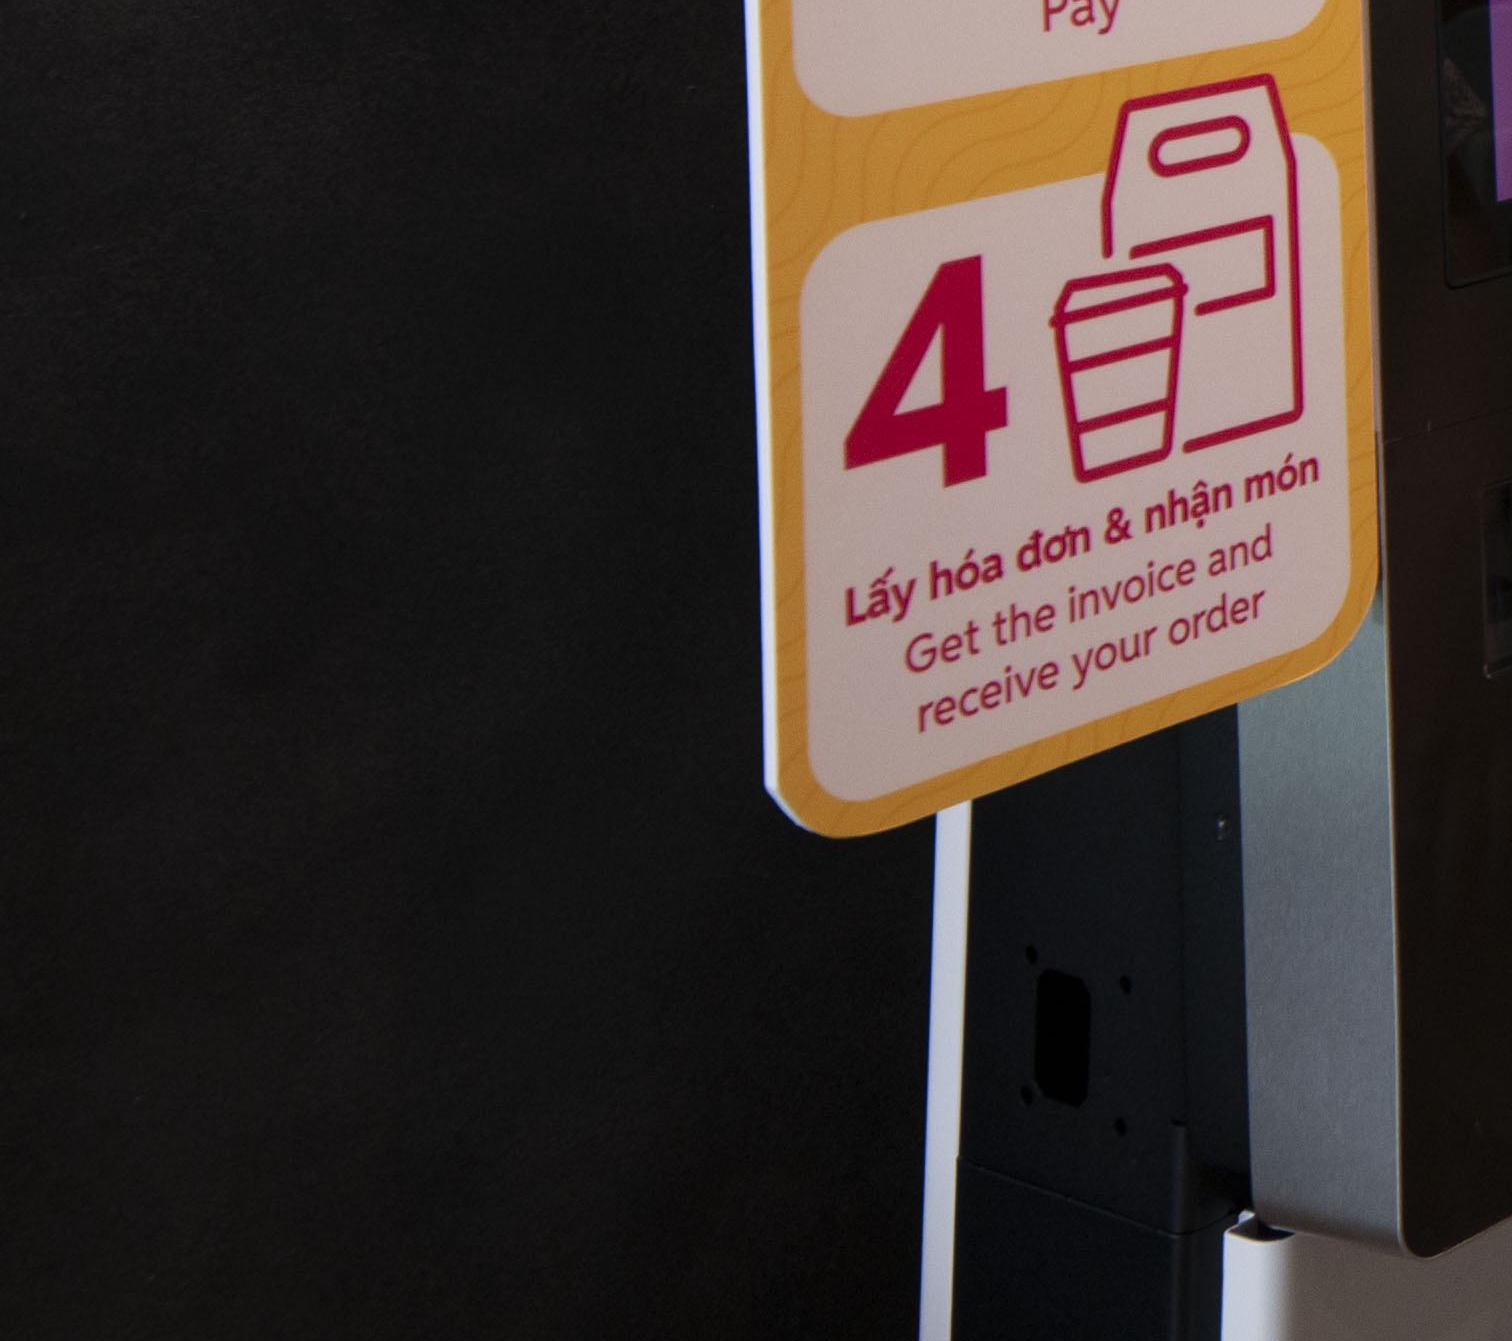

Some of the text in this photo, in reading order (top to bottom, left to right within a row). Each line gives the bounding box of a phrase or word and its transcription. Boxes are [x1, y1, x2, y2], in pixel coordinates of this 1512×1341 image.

[844, 254, 1008, 488] 4
[845, 452, 1320, 626] Lấy hóa đơn & nhận món
[906, 523, 1273, 674] Get the invoice and
[917, 591, 1266, 733] receive your order
